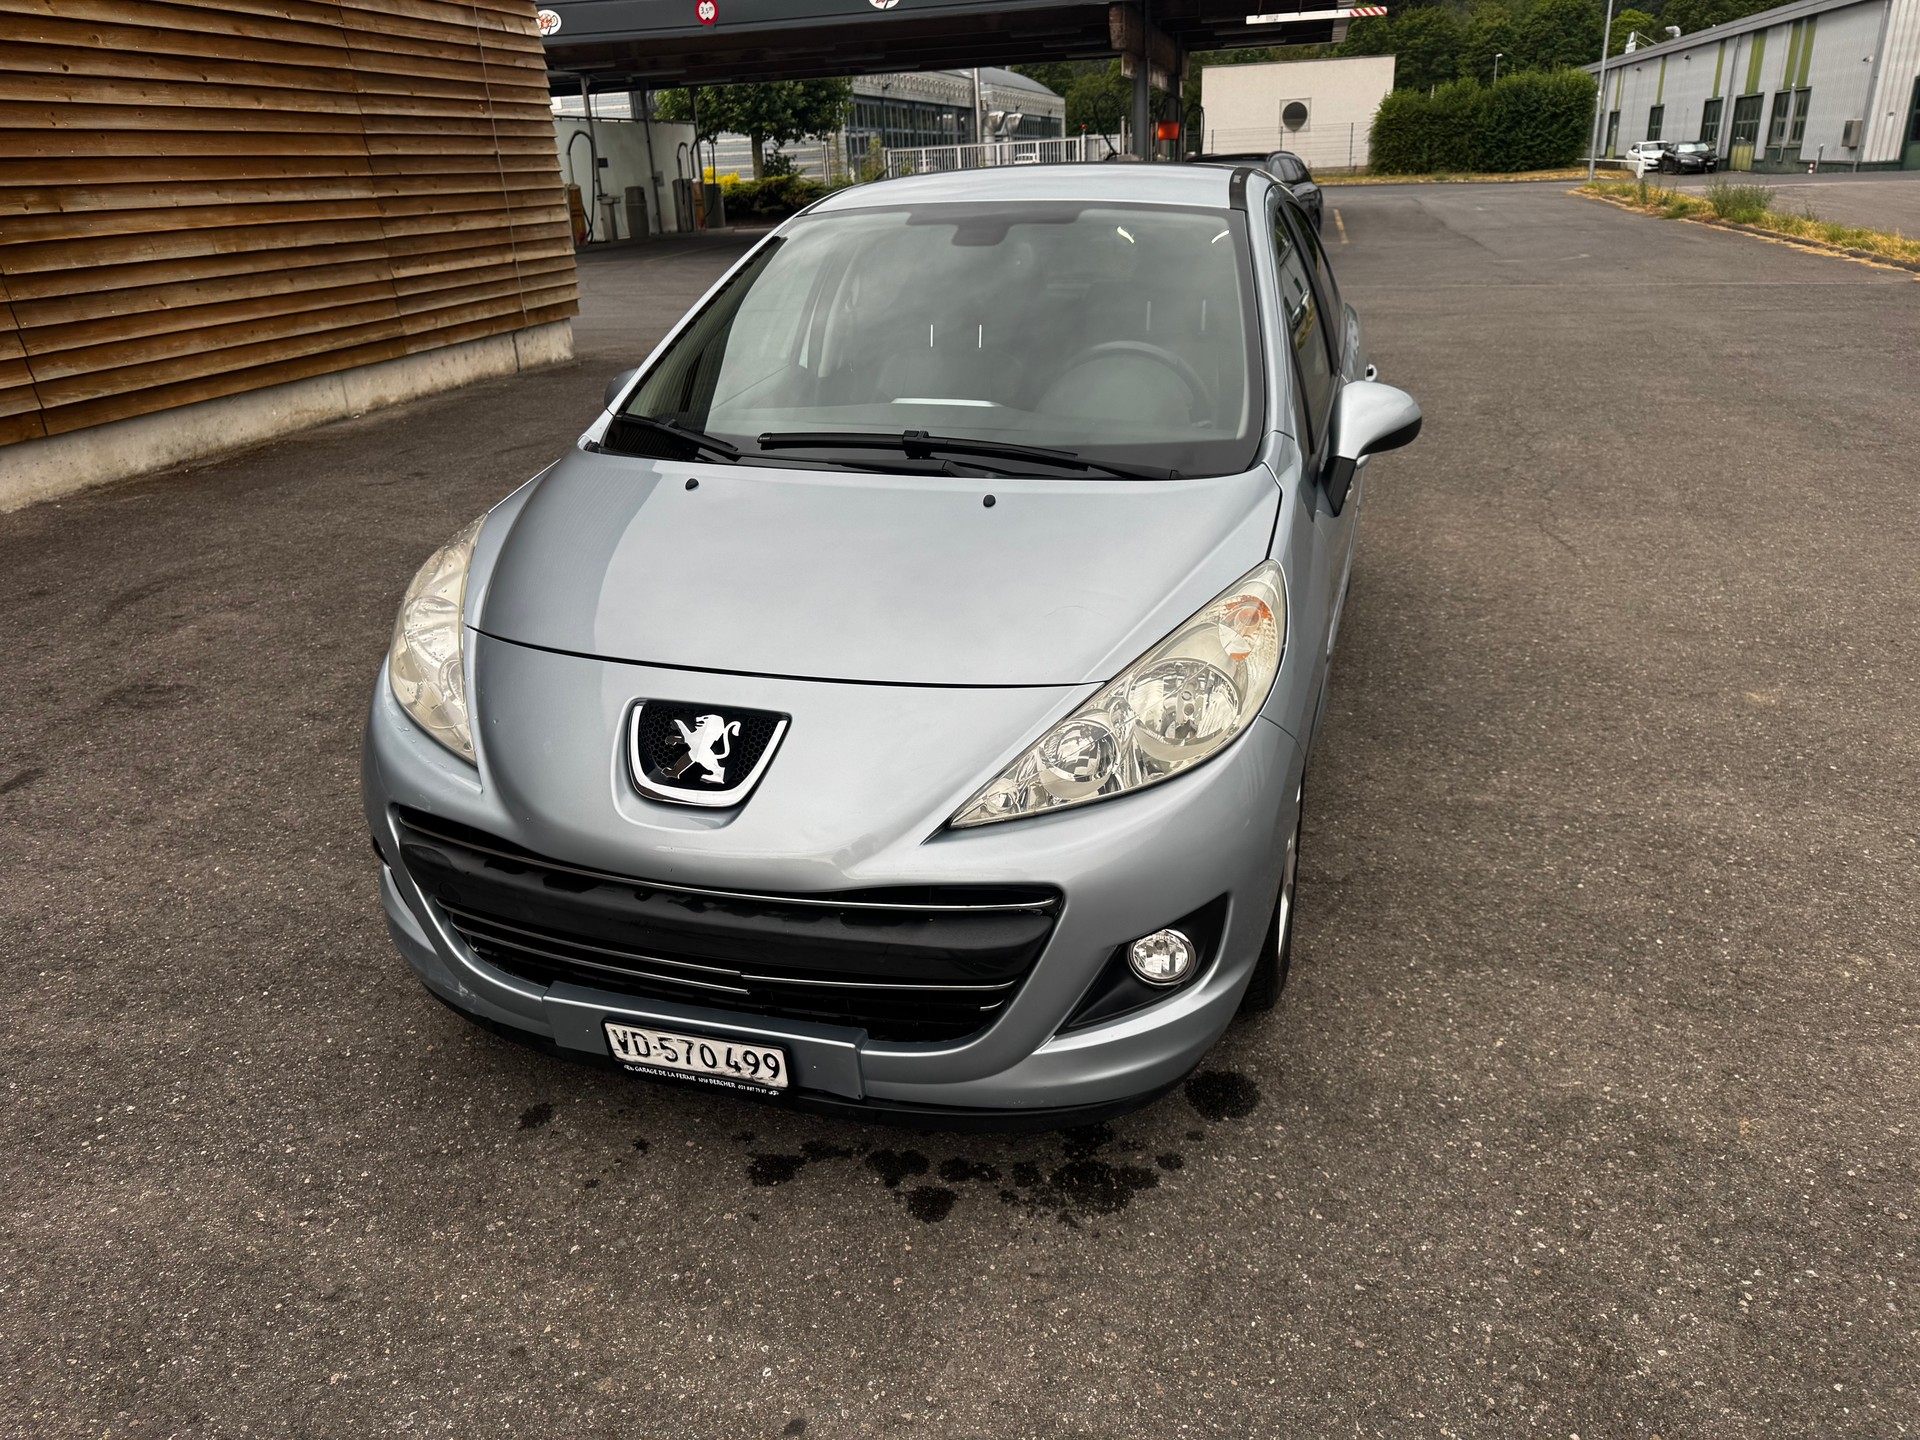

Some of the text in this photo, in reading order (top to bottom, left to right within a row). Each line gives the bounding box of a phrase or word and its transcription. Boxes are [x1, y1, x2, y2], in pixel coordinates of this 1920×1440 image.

[634, 1065, 658, 1076] GARAGE
[658, 1069, 667, 1077] DE
[675, 1072, 697, 1082] FERME
